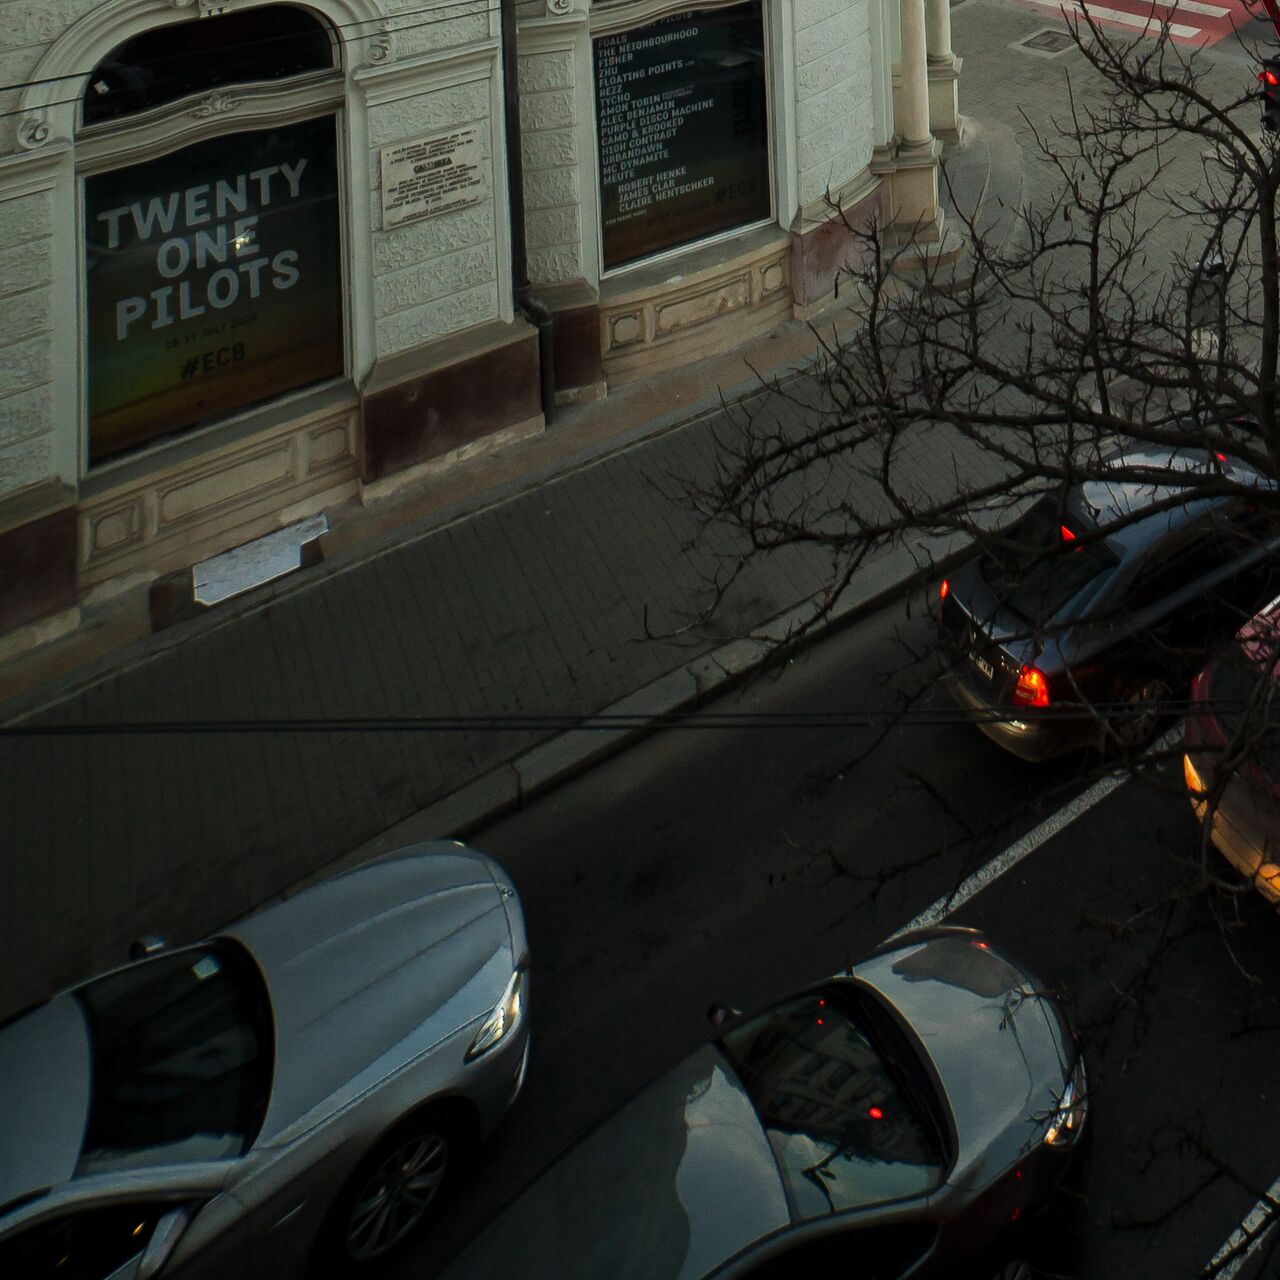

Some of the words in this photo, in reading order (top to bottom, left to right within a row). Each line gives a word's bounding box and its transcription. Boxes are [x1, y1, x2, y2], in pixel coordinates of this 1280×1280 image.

[597, 47, 616, 59] THE
[619, 27, 699, 54] NEIGHBOURHOOD
[598, 34, 628, 49] FOALS
[598, 52, 633, 68] FISHER
[598, 66, 618, 78] ZHU
[599, 68, 646, 88] FLOATING
[648, 59, 684, 76] POINTS
[599, 84, 623, 98] REZZ
[600, 92, 631, 107] TYCHO
[600, 102, 628, 117] AMON
[631, 94, 661, 110] TOBIN
[600, 114, 624, 127] ALEC
[626, 100, 676, 122] BENJAMIN
[601, 118, 637, 137] PURPLE
[640, 110, 669, 126] DISCO
[671, 98, 714, 119] MACHINE
[601, 132, 629, 147] CAMO
[631, 130, 639, 139] &
[642, 116, 684, 136] KROOKED
[602, 143, 627, 156] HIGH
[629, 128, 678, 148] CONTRAST
[602, 143, 663, 166] URBANDAWN
[603, 164, 618, 176] MC
[620, 149, 670, 170] DYNAMITE
[603, 170, 636, 185] MEUTE
[618, 176, 653, 194] ROBERT
[656, 166, 687, 183] HENKE
[96, 157, 309, 249] TWENTY
[618, 188, 649, 204] JAMES
[651, 179, 675, 194] CLAR
[618, 197, 653, 213] CLAIRE
[655, 176, 715, 202] HENTSCHKER
[157, 214, 261, 279] ONE
[116, 249, 301, 342] PILOTS
